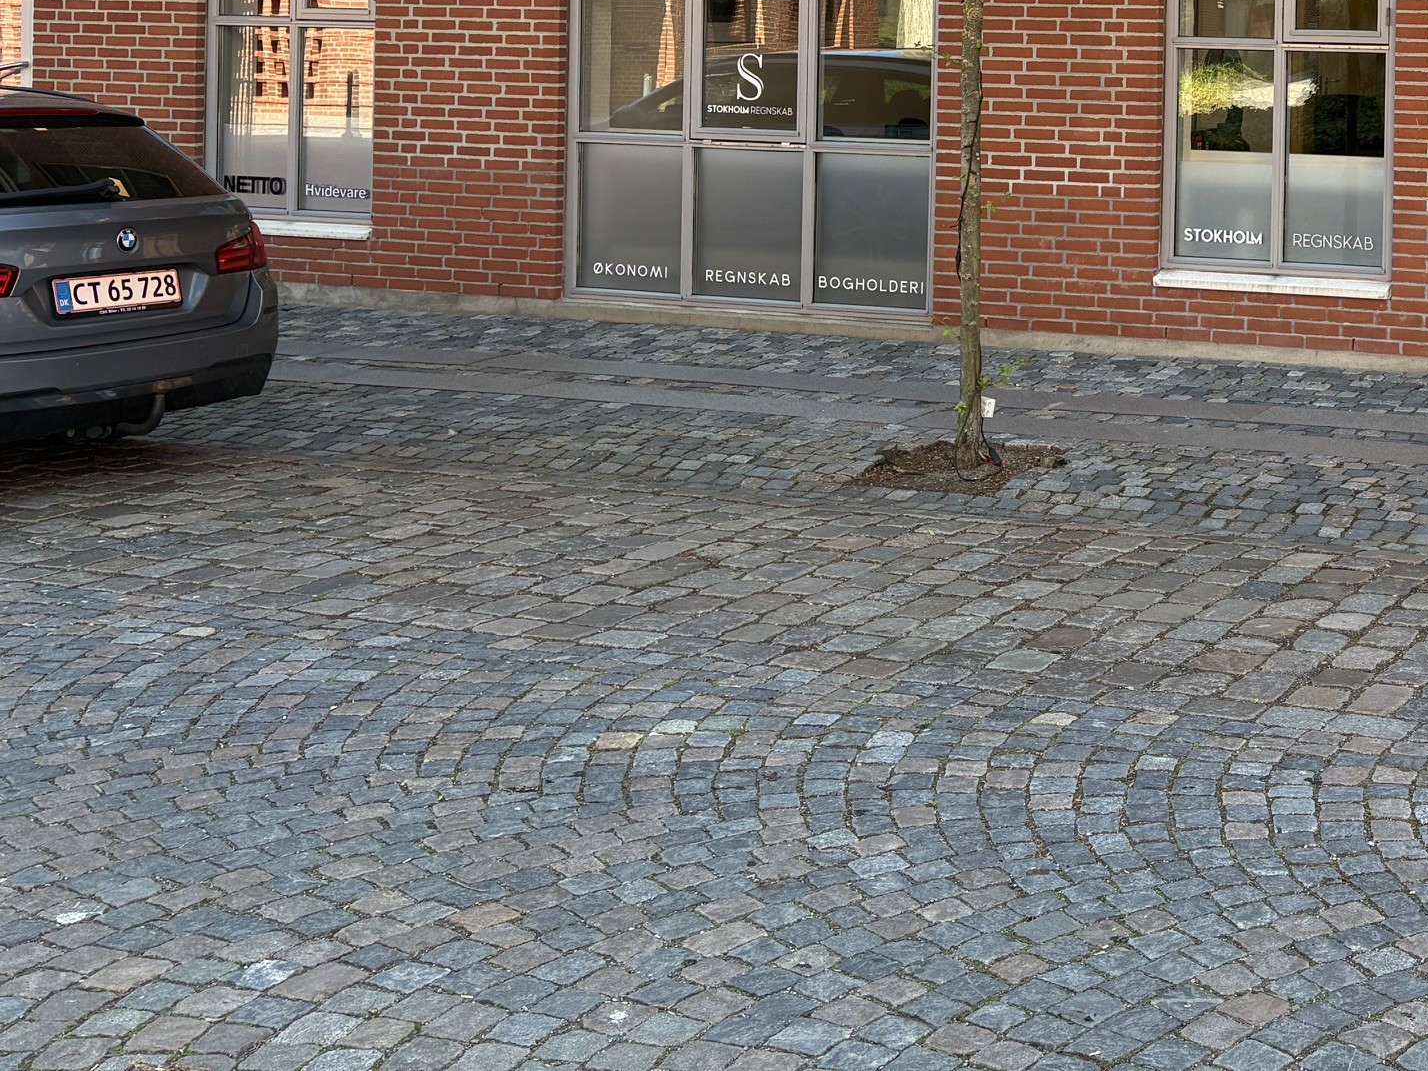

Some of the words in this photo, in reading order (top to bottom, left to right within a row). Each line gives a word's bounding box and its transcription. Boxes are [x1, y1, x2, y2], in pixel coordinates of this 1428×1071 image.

[736, 52, 765, 101] S
[707, 104, 750, 114] STOKHOLM
[750, 106, 793, 116] REGNSKAB
[223, 175, 283, 195] NETTO
[305, 183, 366, 198] Hvidevare
[1184, 228, 1263, 245] STOKHOLM
[1292, 233, 1374, 251] REGNSKAB
[73, 281, 101, 305] CT
[108, 278, 133, 302] 65
[138, 274, 177, 298] 728
[593, 262, 668, 279] ØKONOMI
[705, 269, 791, 287] REGNSKAB
[818, 275, 924, 295] BOGHOLDERI
